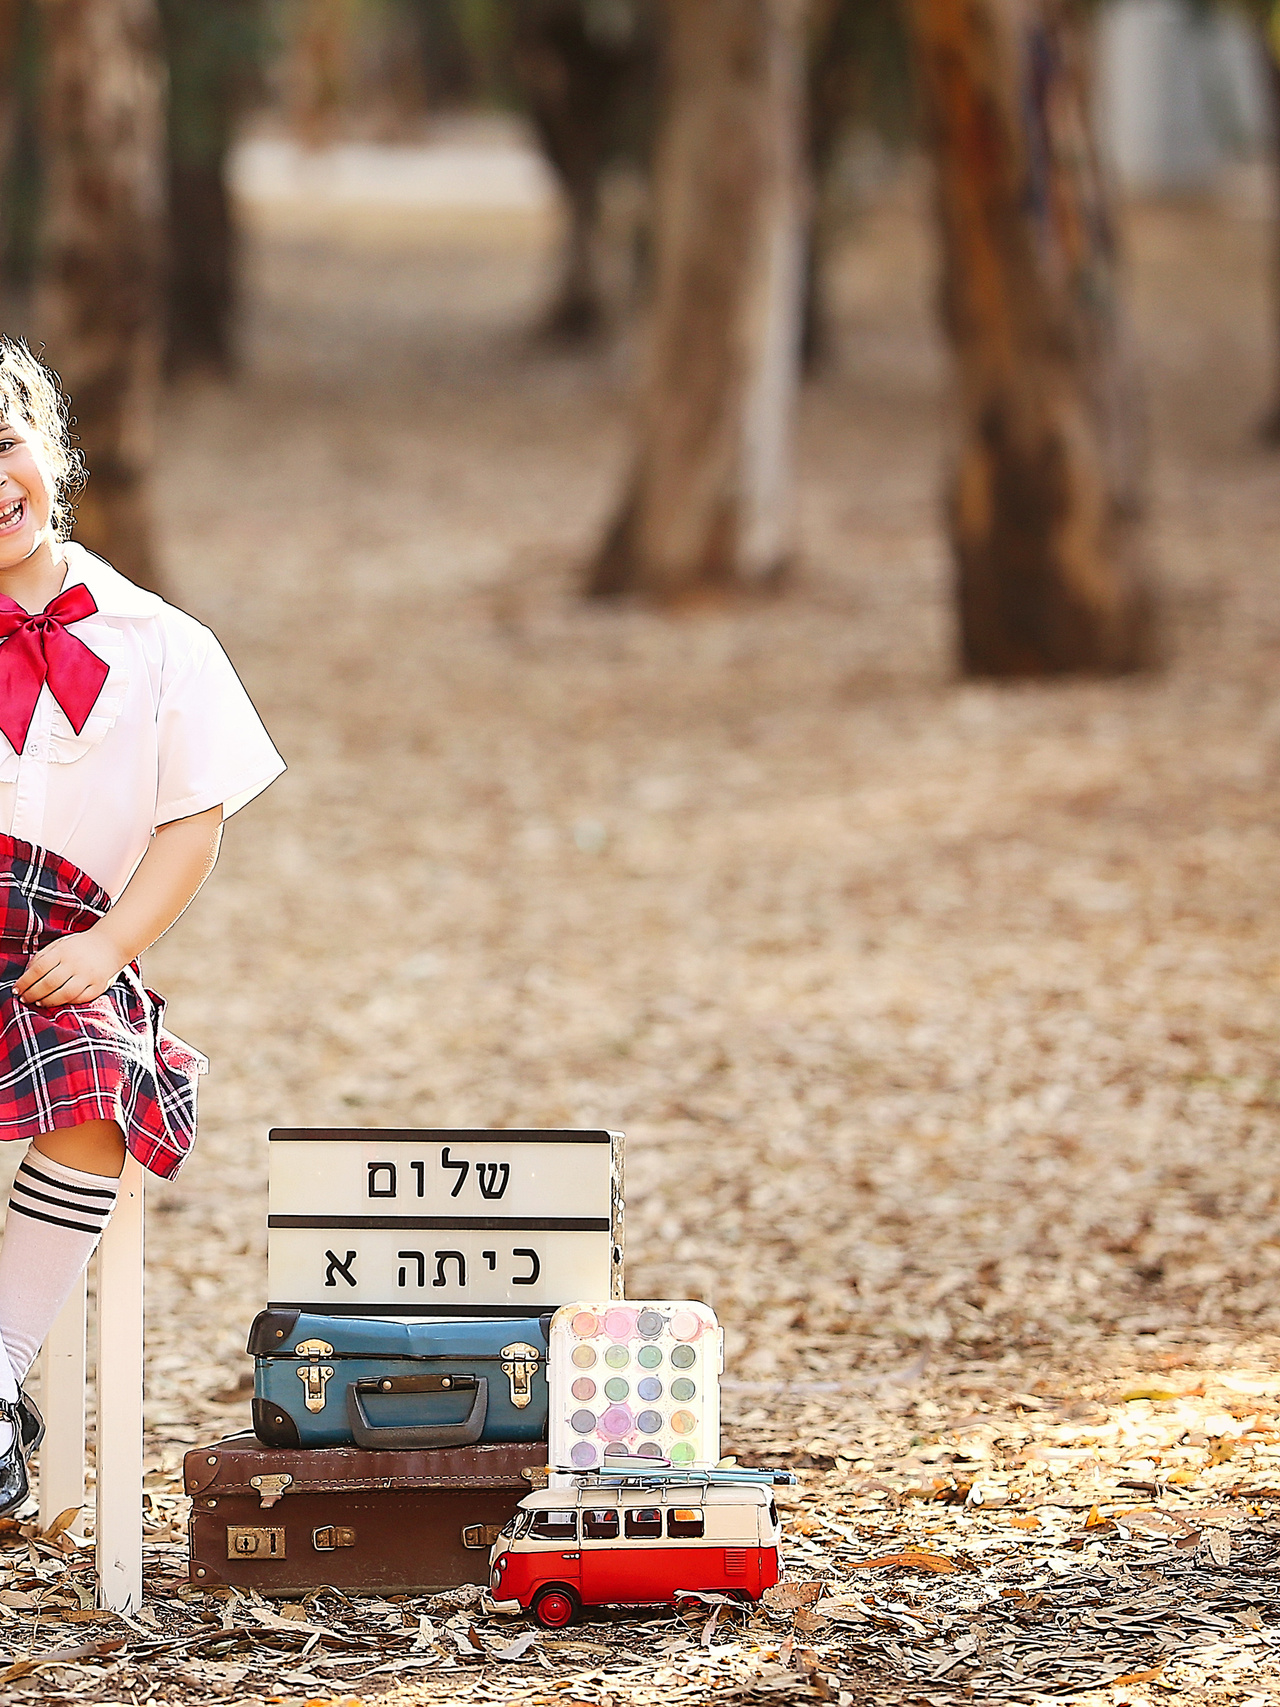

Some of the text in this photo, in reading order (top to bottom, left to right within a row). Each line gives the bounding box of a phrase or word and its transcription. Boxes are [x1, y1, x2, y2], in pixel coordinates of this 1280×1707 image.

[367, 1147, 510, 1200] שלום
[324, 1247, 541, 1288] כיתה א
